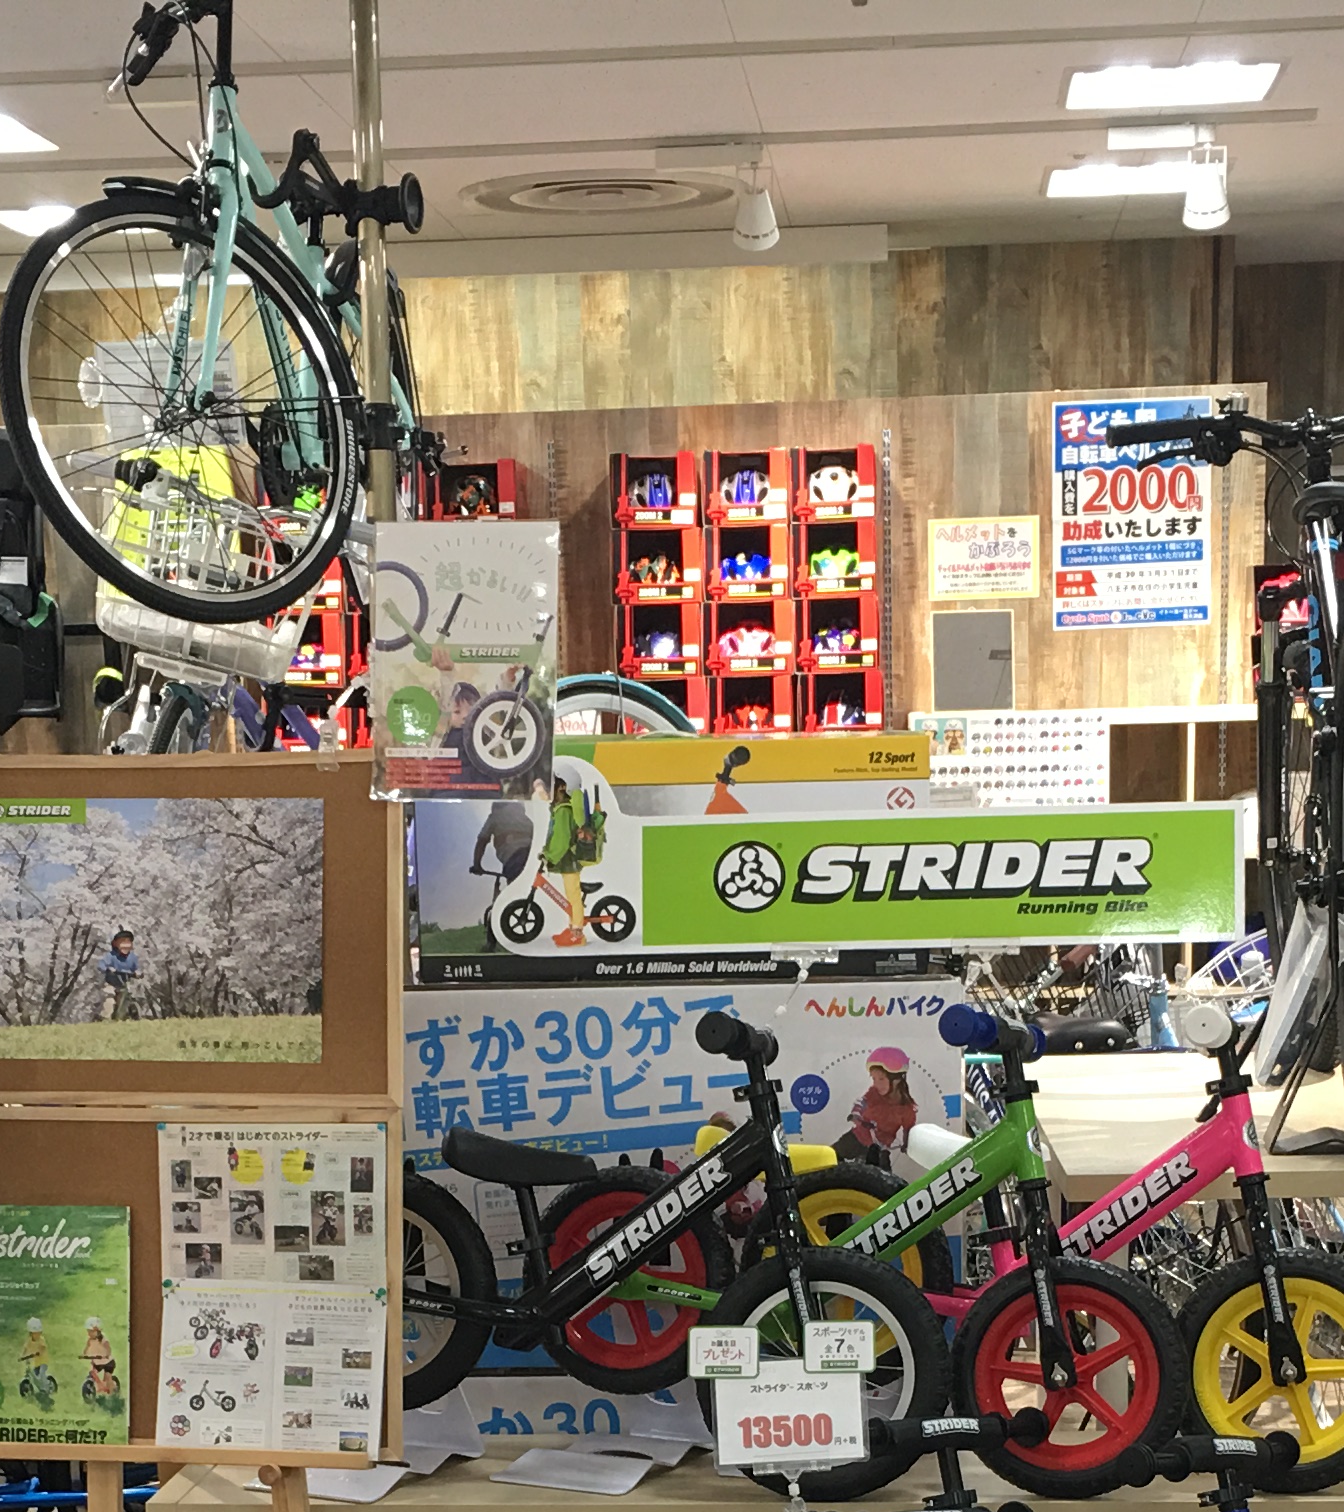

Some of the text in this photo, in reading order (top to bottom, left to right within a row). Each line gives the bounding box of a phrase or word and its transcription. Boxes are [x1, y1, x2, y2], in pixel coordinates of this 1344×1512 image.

[1062, 516, 1203, 541] 助成いたします
[968, 540, 1032, 559] かぶろう
[460, 648, 520, 658] STRIDER
[868, 751, 915, 765] 12 Sport
[7, 804, 71, 817] STRIDER
[791, 836, 1154, 904] STRIDER
[1017, 898, 1149, 916] Running Bike
[596, 960, 778, 975] Over 1.6 Million Sold Worldwide
[804, 994, 946, 1018] へんしんバイク
[237, 1131, 329, 1142] はじめてのストライダー
[586, 1154, 732, 1285] STRIDER
[711, 1340, 737, 1348] お誕生日
[824, 1338, 855, 1354] 全7色
[703, 1348, 745, 1360] プレゼント
[750, 1381, 828, 1393] ストライダー スポーツ
[737, 1413, 833, 1449] 13500
[921, 1417, 981, 1437] STRIDER
[1213, 1438, 1258, 1455] STRIDER
